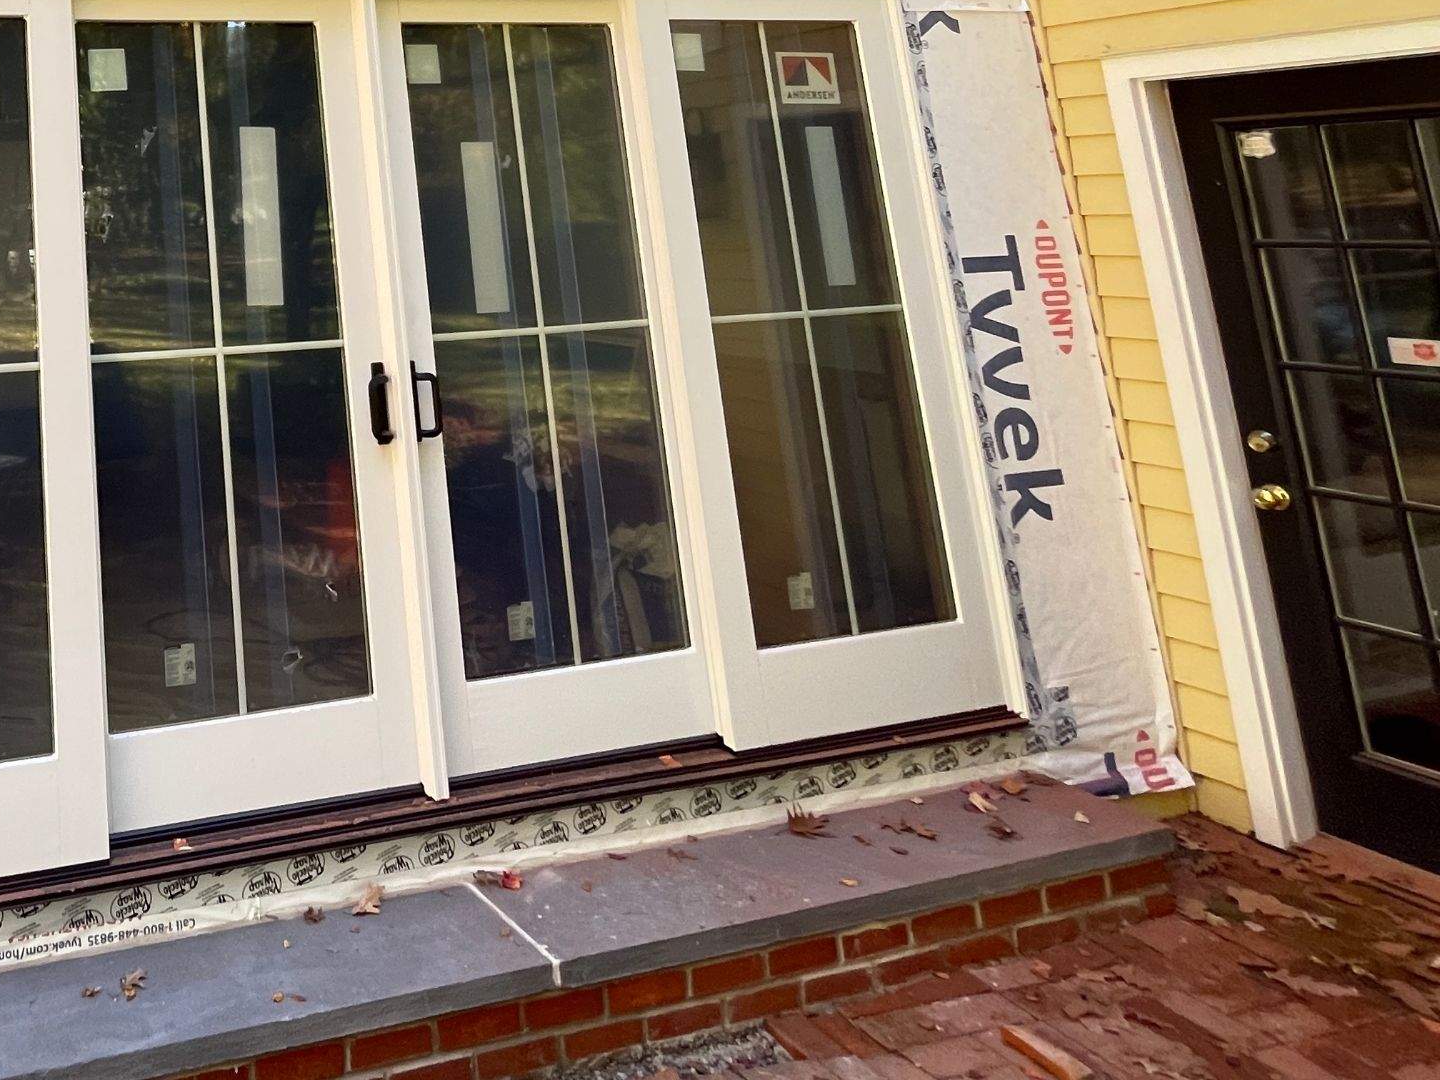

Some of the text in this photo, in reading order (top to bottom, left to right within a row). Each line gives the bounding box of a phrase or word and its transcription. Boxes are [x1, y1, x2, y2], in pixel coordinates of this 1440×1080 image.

[787, 90, 837, 101] ANDERSEN
[1033, 236, 1074, 341] DUPONT
[962, 235, 1066, 528] Tyvek
[88, 922, 174, 947] 1-800-448-9835
[175, 918, 196, 931] Call
